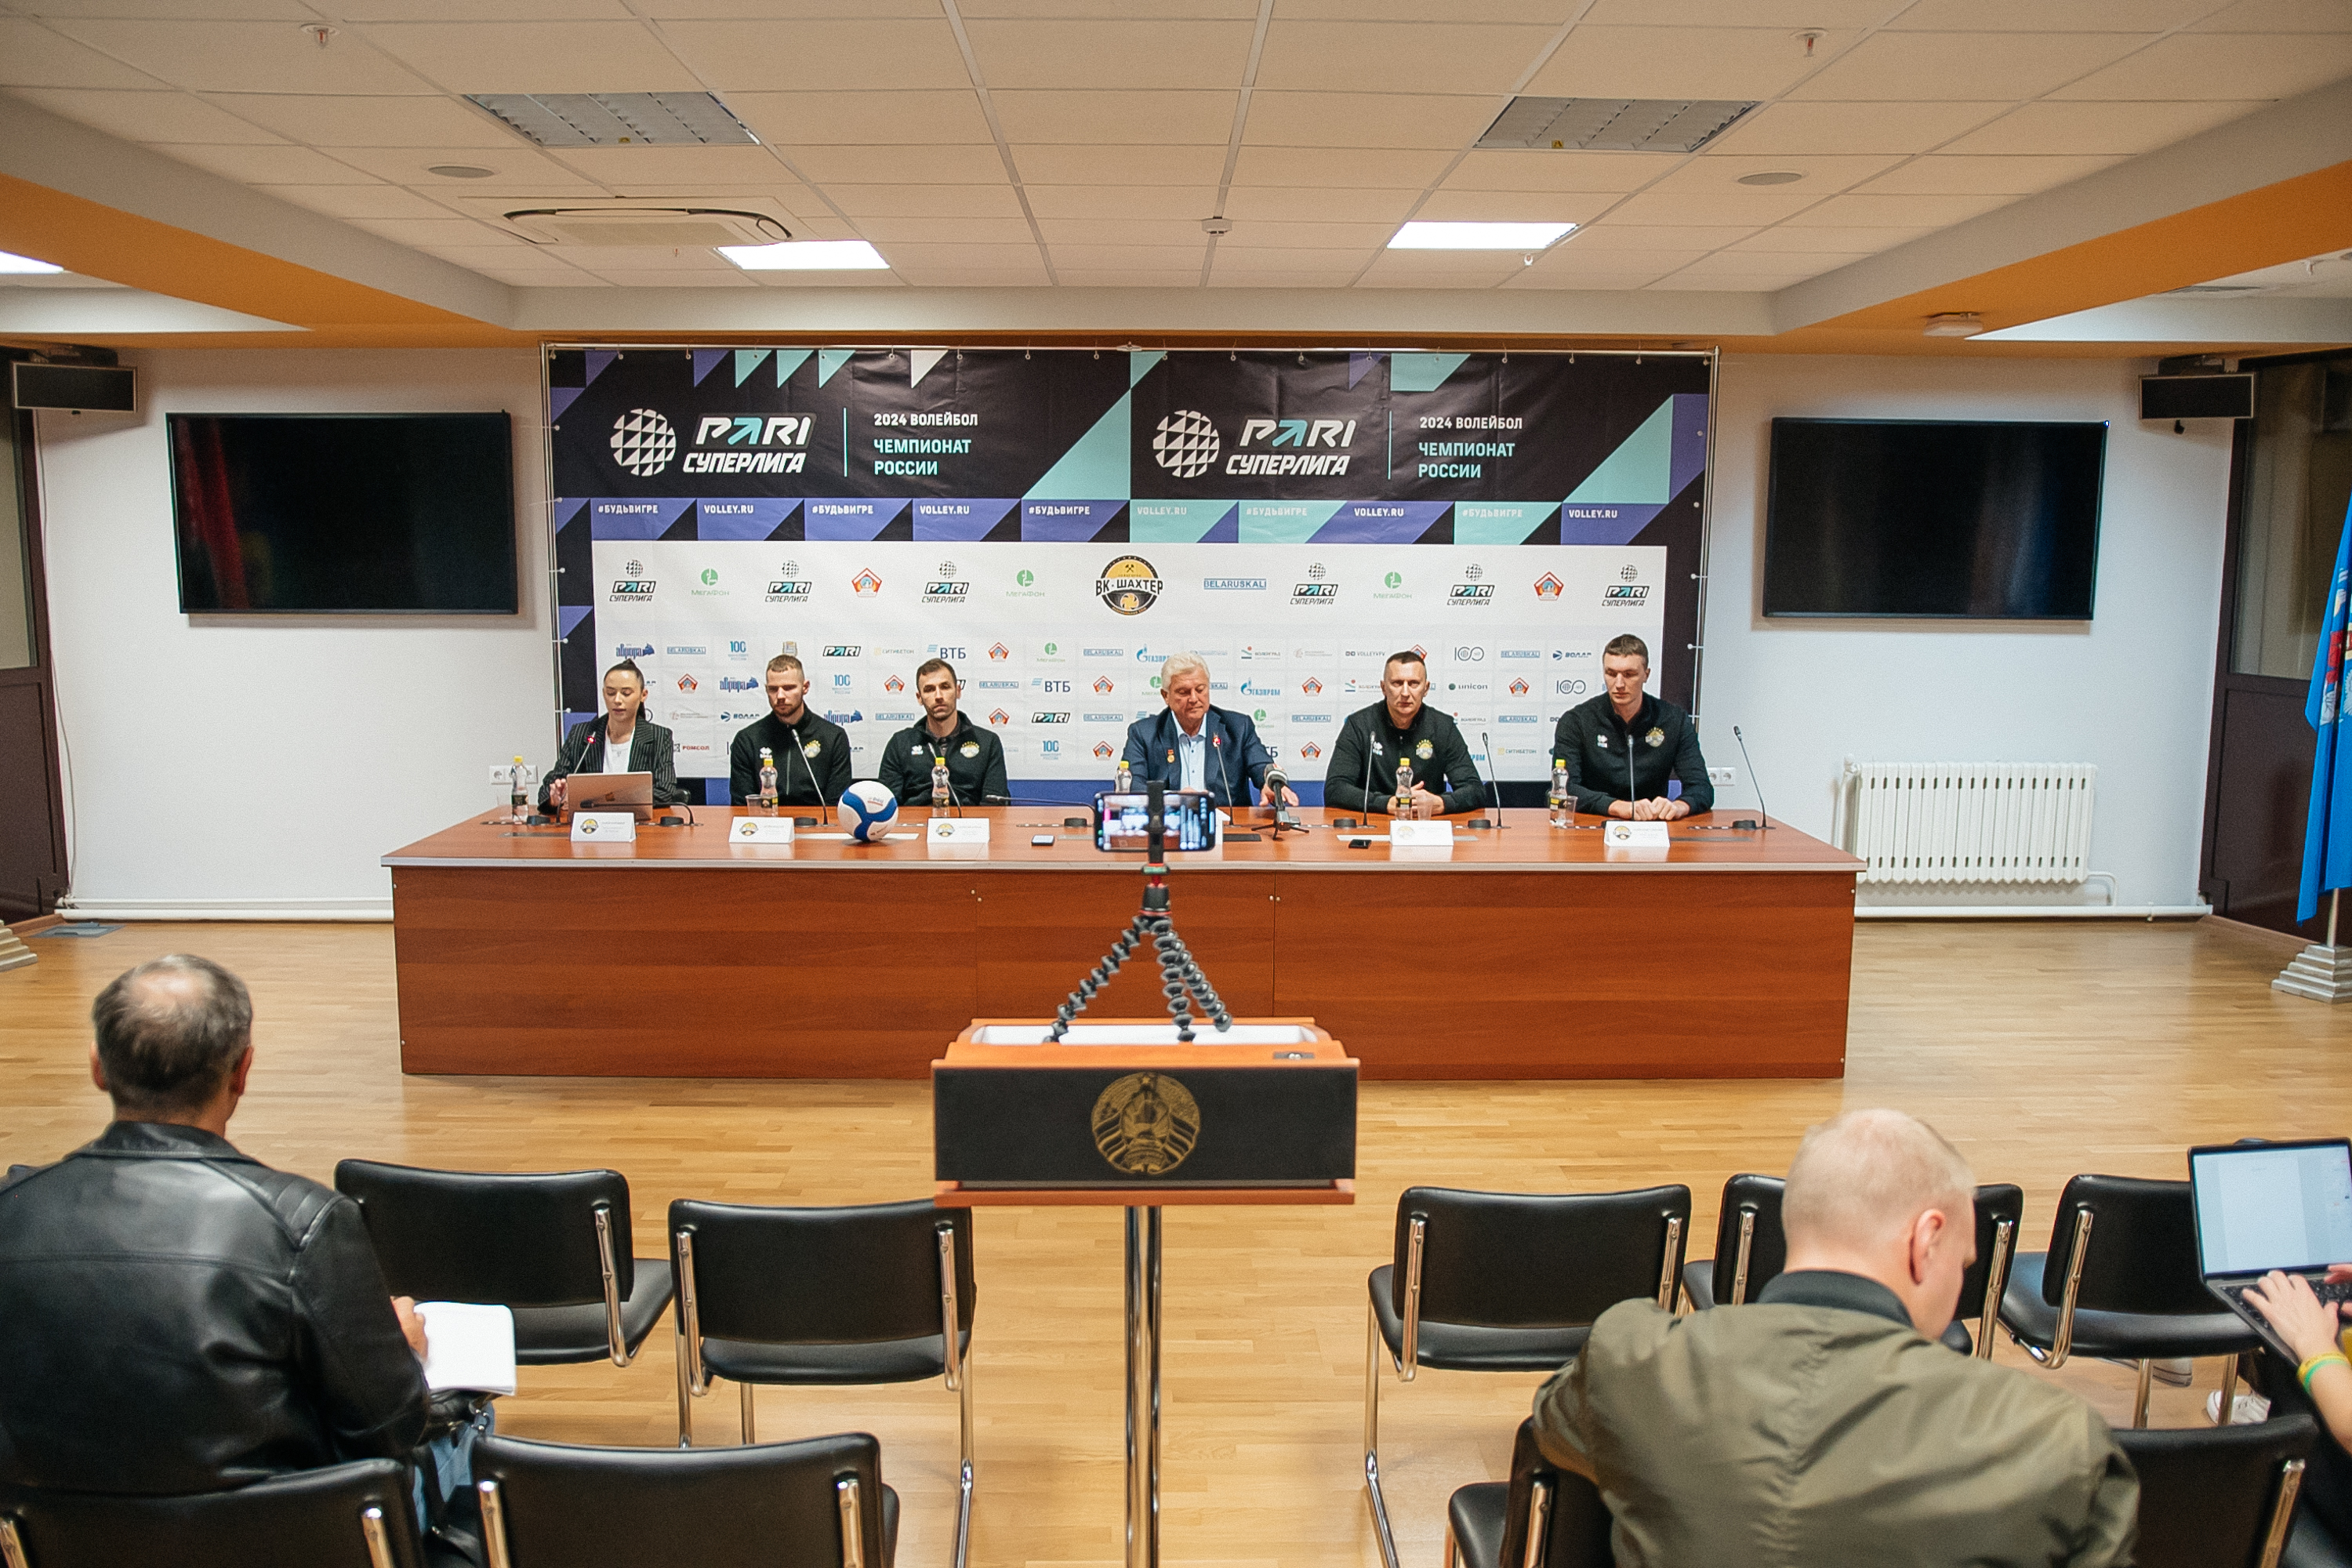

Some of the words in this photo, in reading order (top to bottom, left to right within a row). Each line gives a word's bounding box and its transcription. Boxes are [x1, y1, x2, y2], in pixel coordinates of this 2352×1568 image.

[873, 413, 908, 426] 2024
[910, 411, 978, 426] ВОЛЕЙБОЛ
[1419, 416, 1453, 430] 2024
[1456, 415, 1523, 430] ВОЛЕЙБОЛ
[695, 416, 811, 445] PARI
[1239, 419, 1357, 448] PARI
[873, 438, 972, 454] ЧЕМПИОНАТ
[1418, 442, 1515, 457] ЧЕМПИОНАТ
[682, 452, 807, 474] СУПЕРЛИГА
[874, 460, 938, 476] РОССИИ
[1225, 454, 1351, 476] СУПЕРЛИГА
[1418, 463, 1481, 478] РОССИИ
[598, 504, 659, 514] #БУДЬВИГРЕ
[704, 504, 754, 514] VOLLEY.RU
[812, 505, 873, 515] #БУДЬВИГРЕ
[920, 505, 970, 515] VOLLEY.RU
[1029, 506, 1091, 515] #БУДЬВИГРЕ
[1137, 506, 1187, 515] VOLLEY.RU
[1247, 506, 1308, 517] #БУДЬВИГРЕ
[1354, 507, 1404, 517] VOLLEY.RU
[1462, 508, 1523, 518] #БУДЬВИГРЕ
[1569, 509, 1618, 519] VOLLEY.RU
[613, 583, 655, 592] PARI
[768, 583, 811, 593] PARI
[925, 583, 967, 593] PARI
[1096, 580, 1109, 596] ВК
[1117, 579, 1163, 595] ШАХТЕР
[1294, 585, 1336, 595] PARI
[1451, 586, 1493, 596] PARI
[1606, 586, 1648, 597] PARI
[940, 648, 966, 659] ВТБ
[1045, 681, 1070, 692] ВТБ
[1033, 713, 1069, 722] PARI
